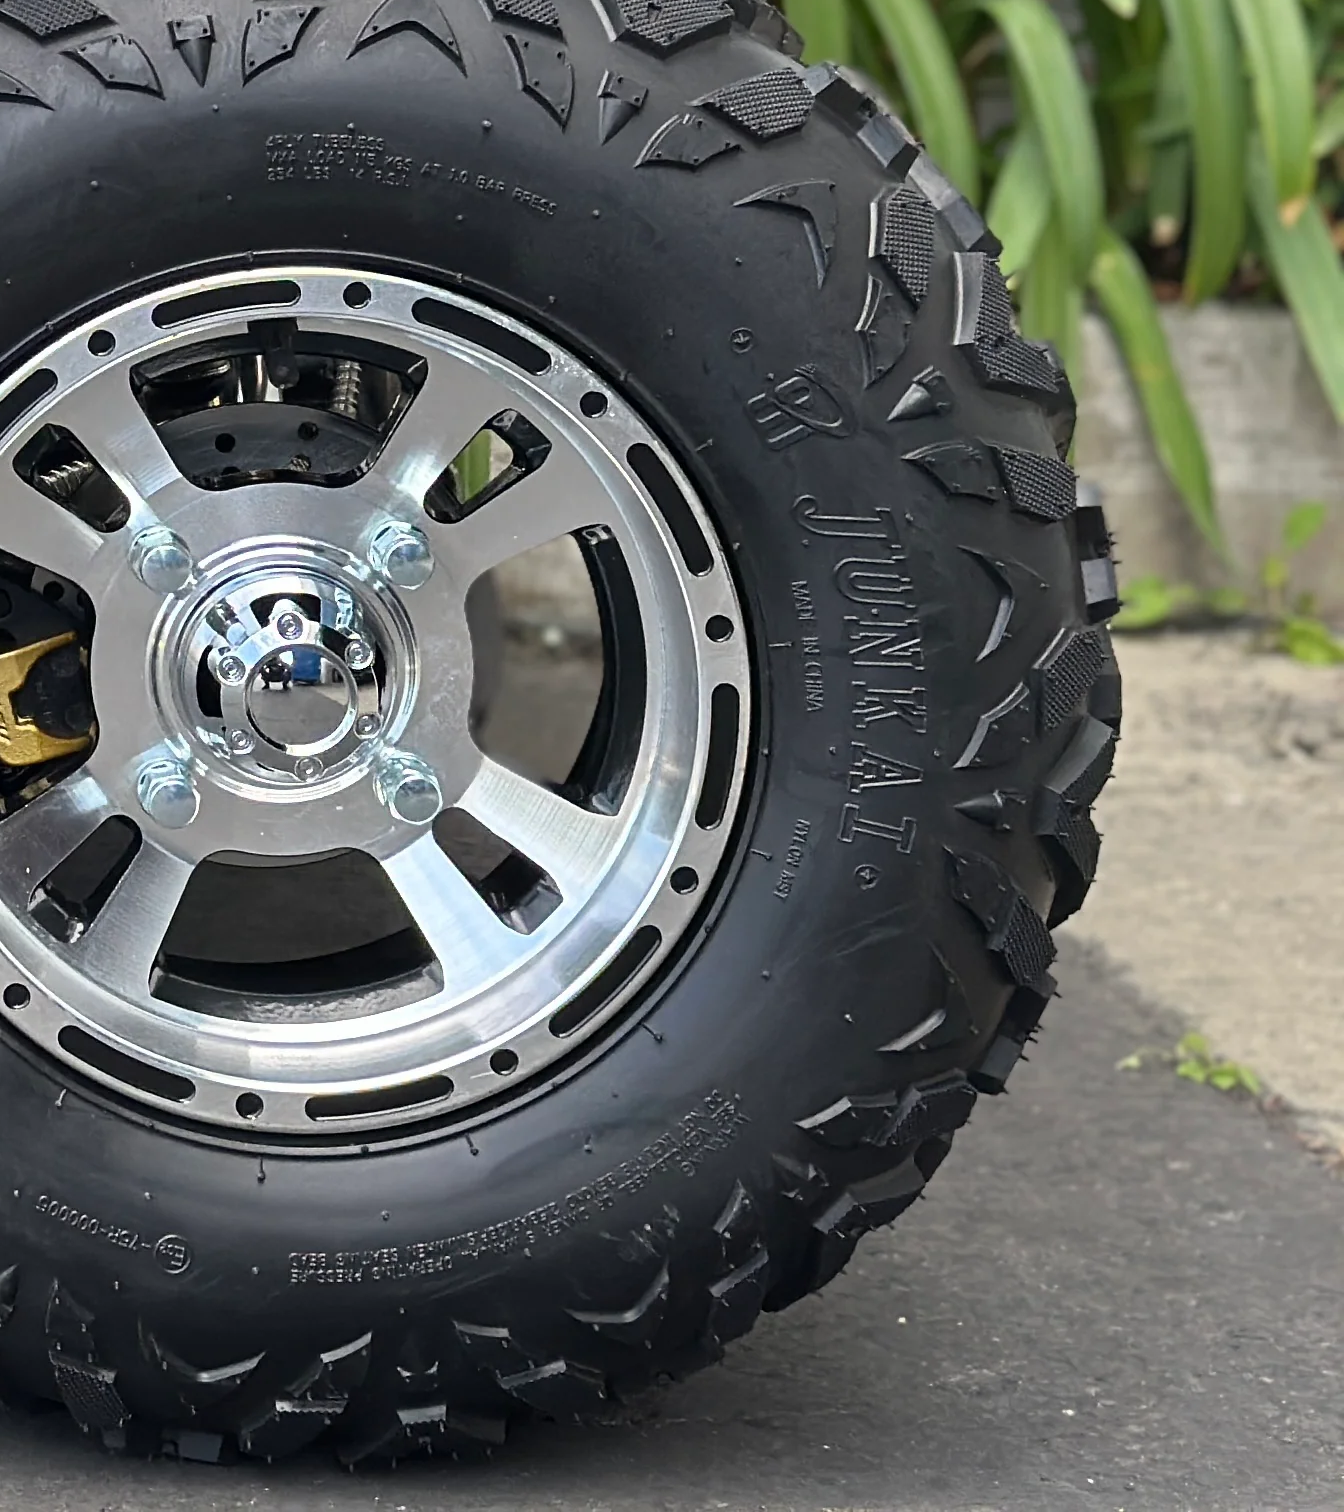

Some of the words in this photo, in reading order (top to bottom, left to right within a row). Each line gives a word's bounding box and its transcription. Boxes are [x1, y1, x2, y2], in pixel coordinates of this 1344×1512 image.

[311, 132, 384, 151] TUBELESS
[801, 636, 821, 653] IN
[791, 494, 928, 855] JUNKAI
[804, 660, 824, 712] CHINA
[785, 818, 812, 865] NYLON
